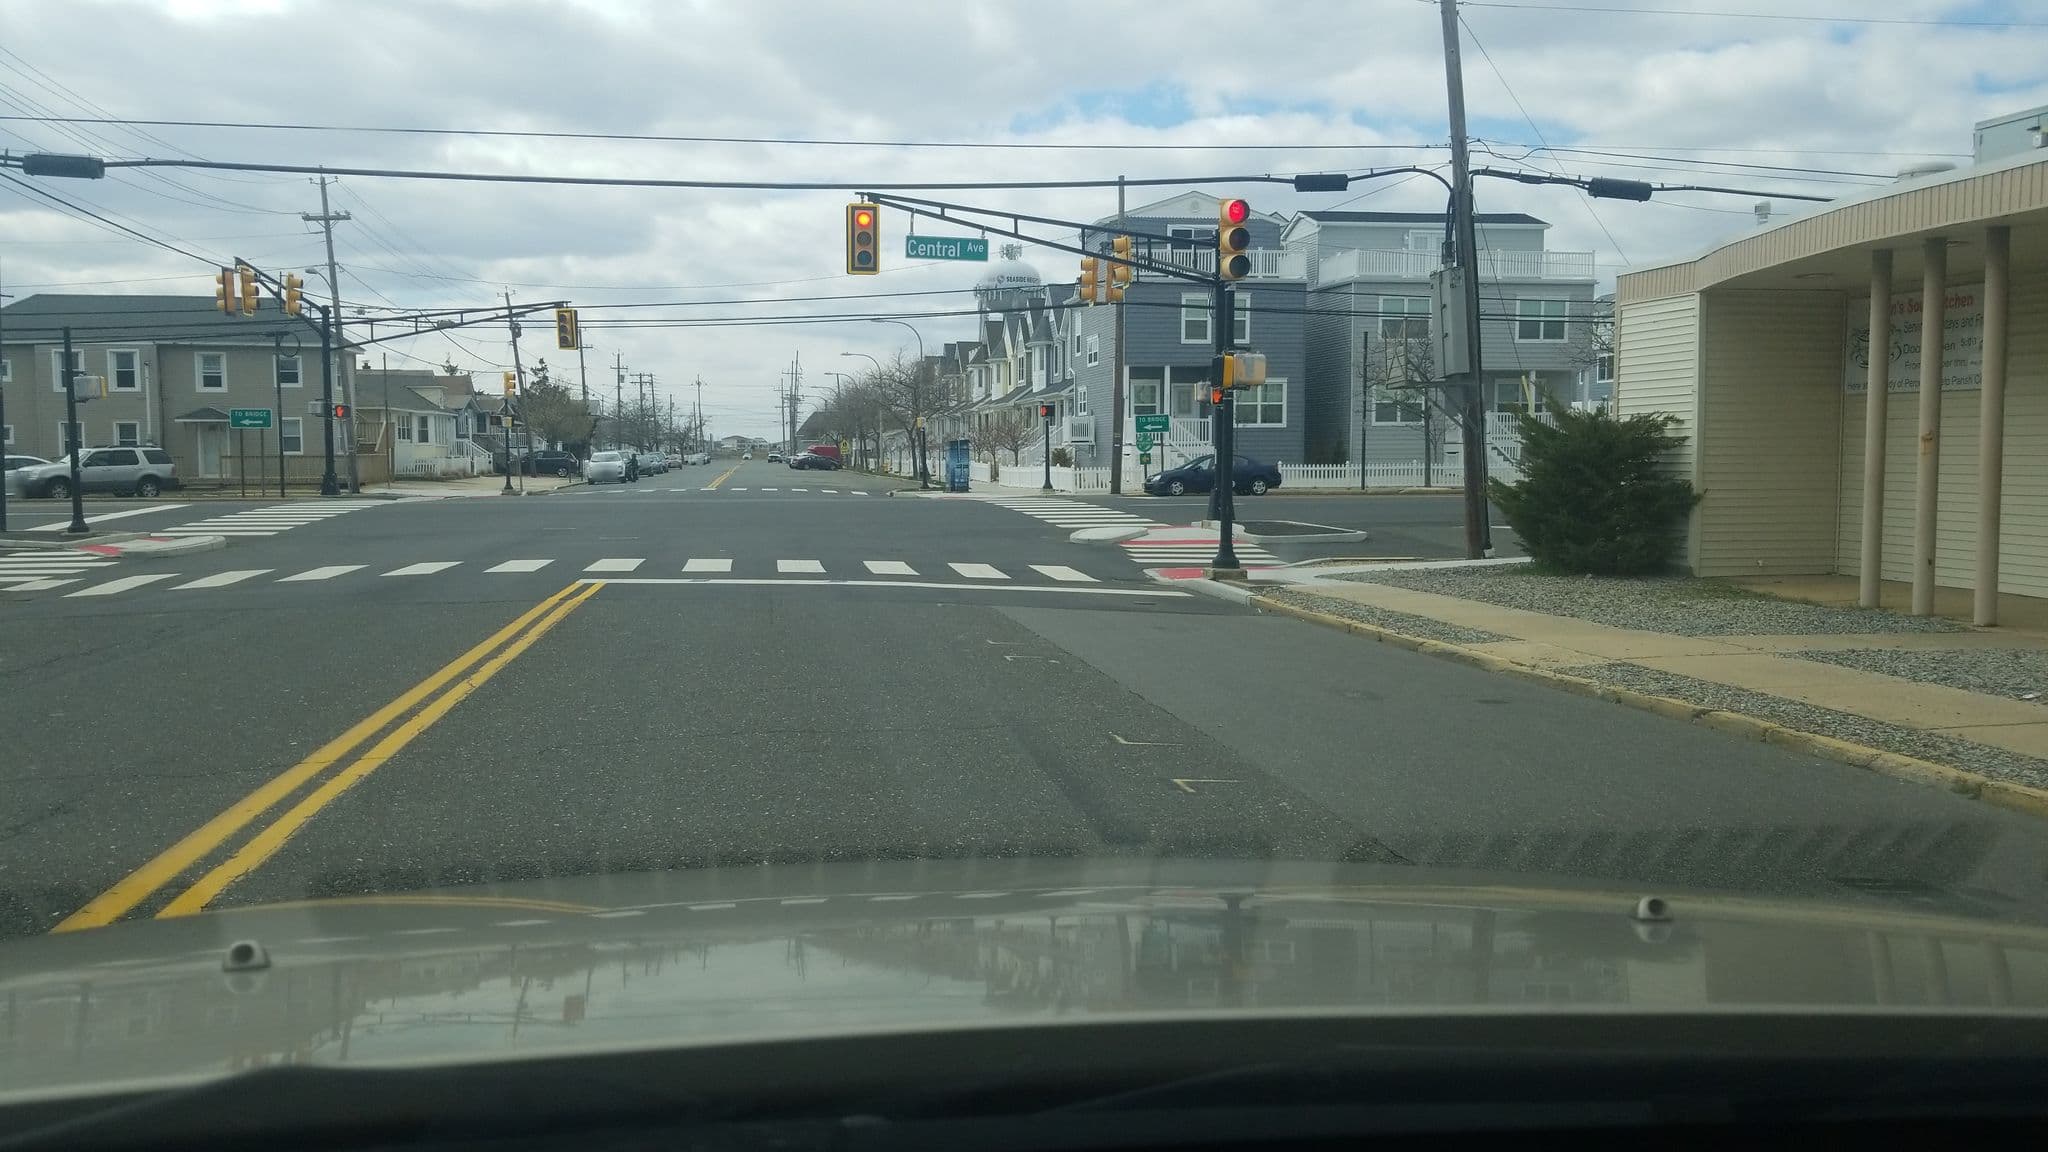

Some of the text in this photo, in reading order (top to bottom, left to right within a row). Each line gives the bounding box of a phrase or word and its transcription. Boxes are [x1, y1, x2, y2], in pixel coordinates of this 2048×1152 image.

[908, 239, 984, 257] Central Ave
[1903, 343, 1921, 354] Doo
